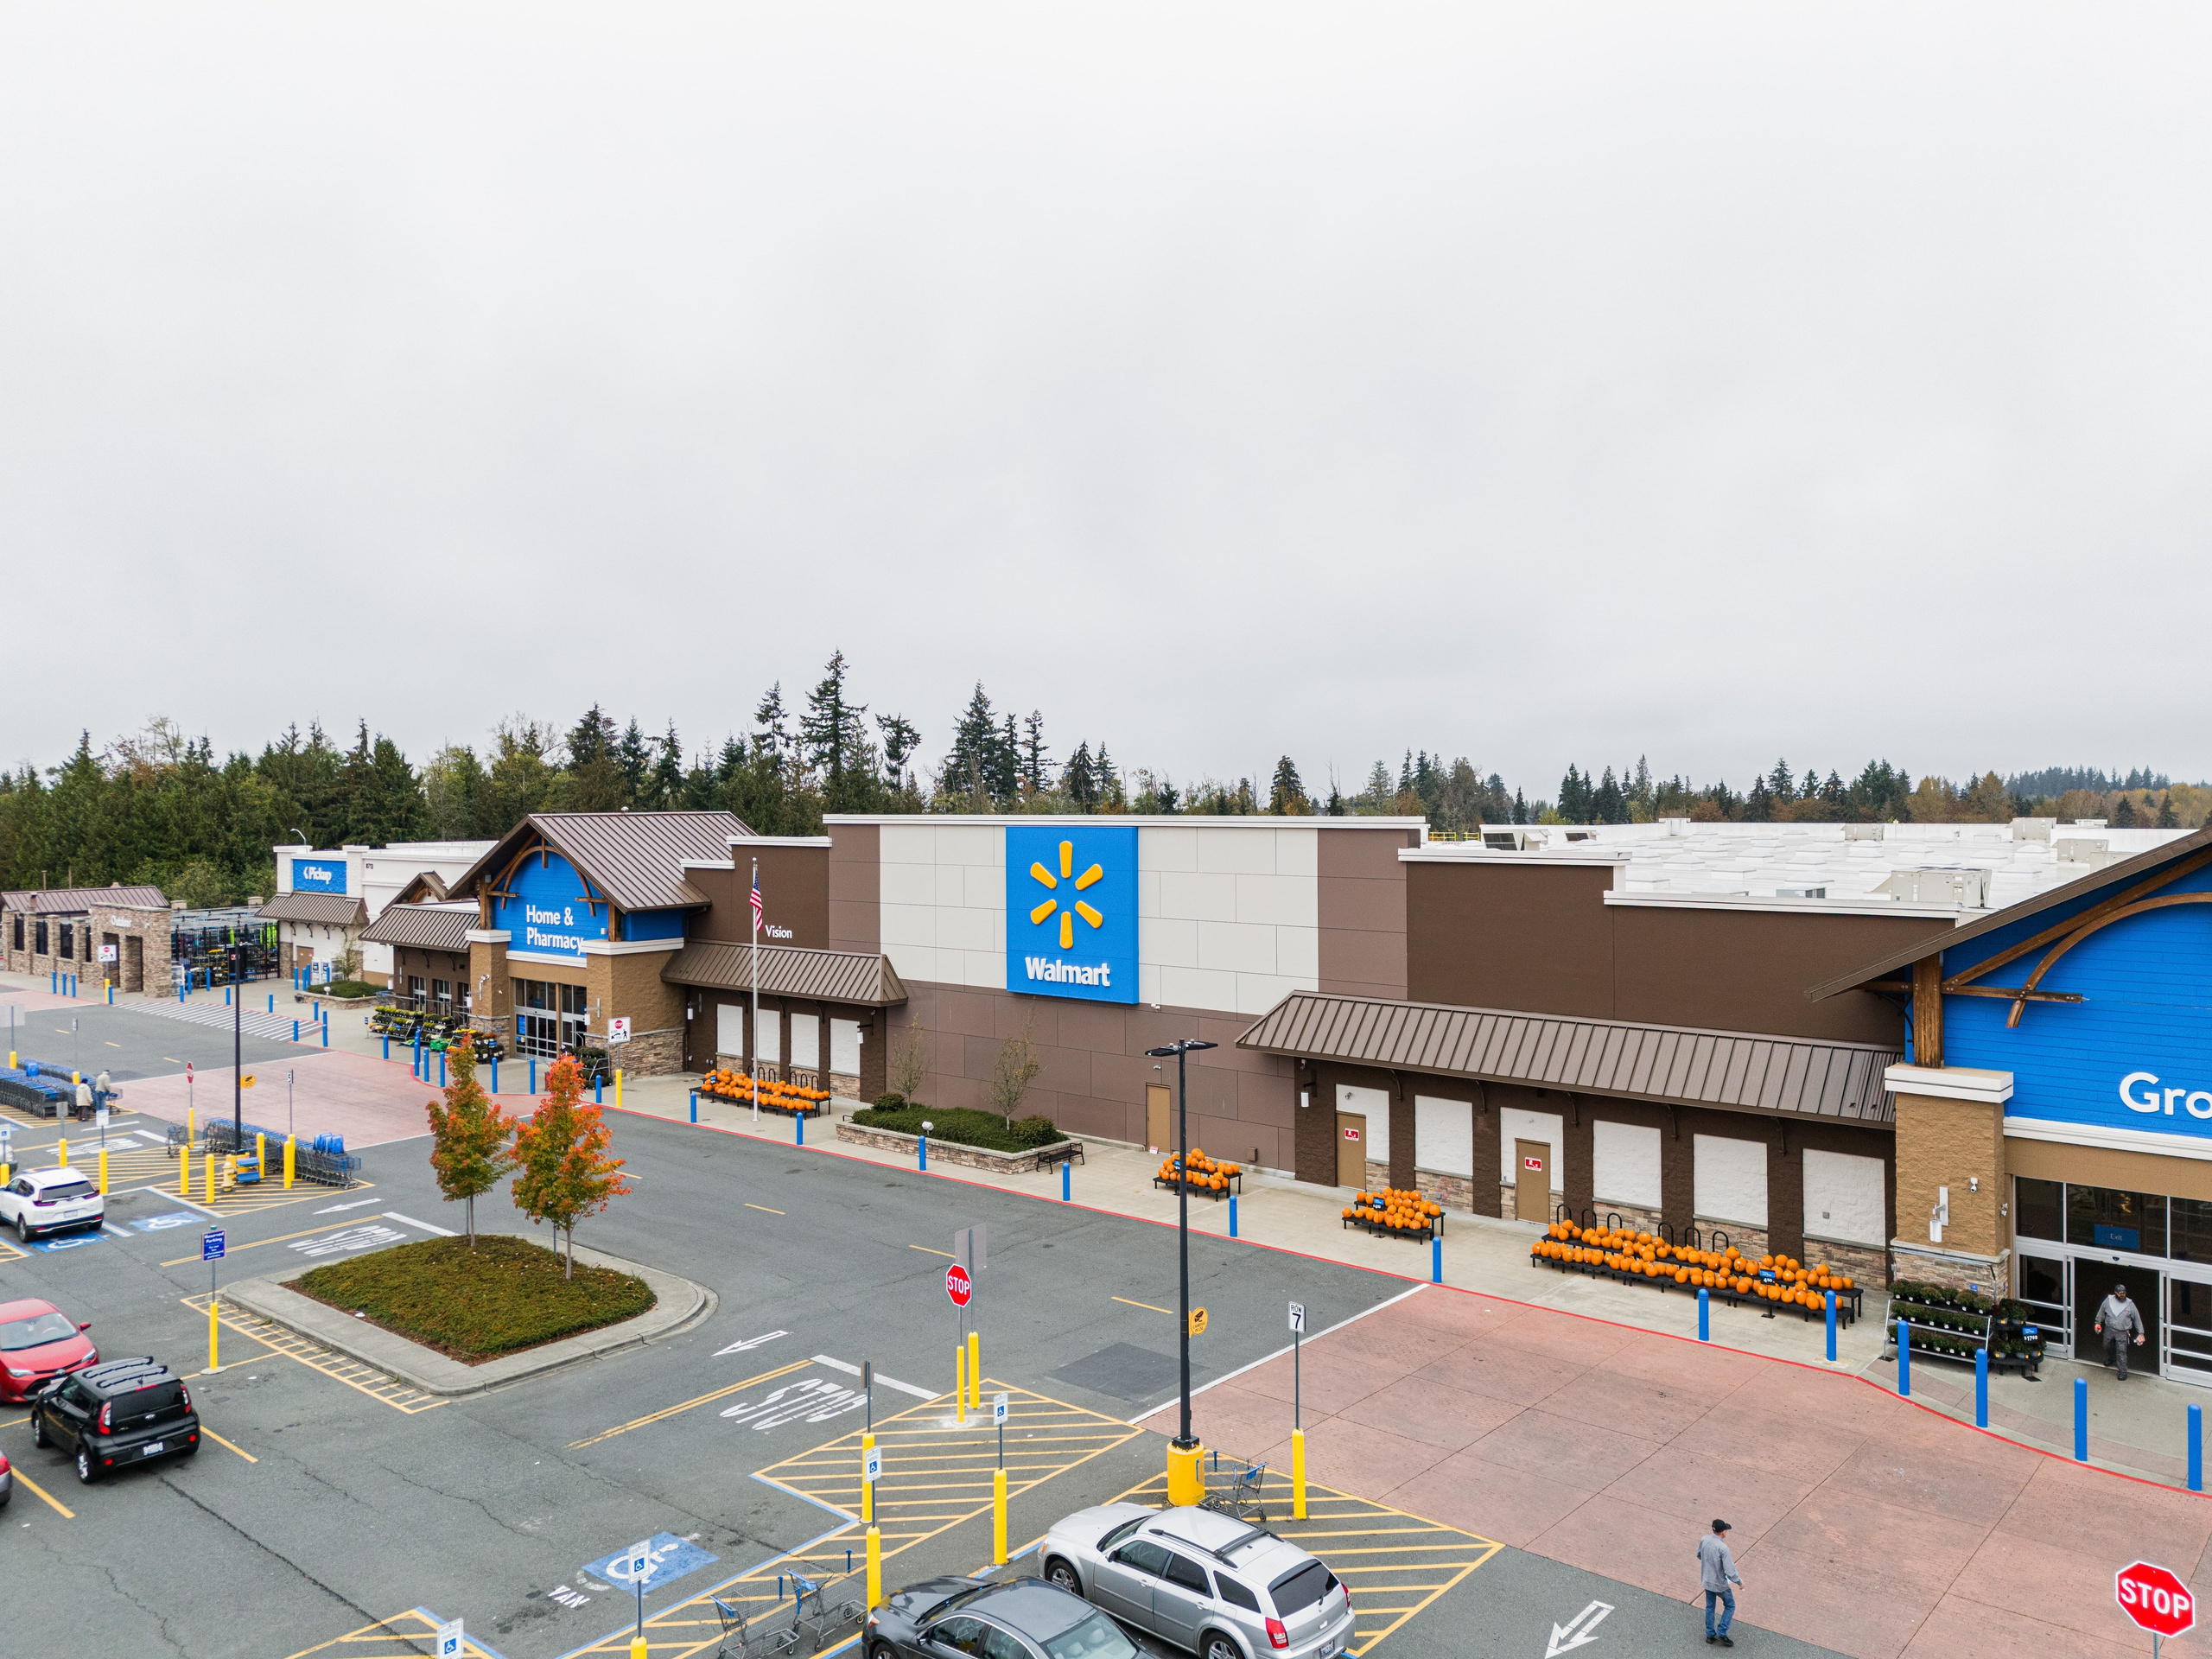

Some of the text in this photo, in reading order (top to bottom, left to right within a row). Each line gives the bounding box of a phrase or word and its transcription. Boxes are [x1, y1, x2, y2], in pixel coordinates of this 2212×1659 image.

[526, 904, 574, 926] Home &
[526, 926, 584, 956] Pharmacy
[765, 925, 793, 939] Vision
[1025, 957, 1111, 987] Walmart
[2120, 1071, 2212, 1119] Gro
[287, 1224, 408, 1257] STOP
[948, 1275, 969, 1295] STOP
[1291, 1305, 1302, 1313] ROW
[1292, 1313, 1301, 1330] 7
[719, 1378, 873, 1431] STOP
[548, 1585, 591, 1609] VAN
[2120, 1578, 2190, 1619] STOP
